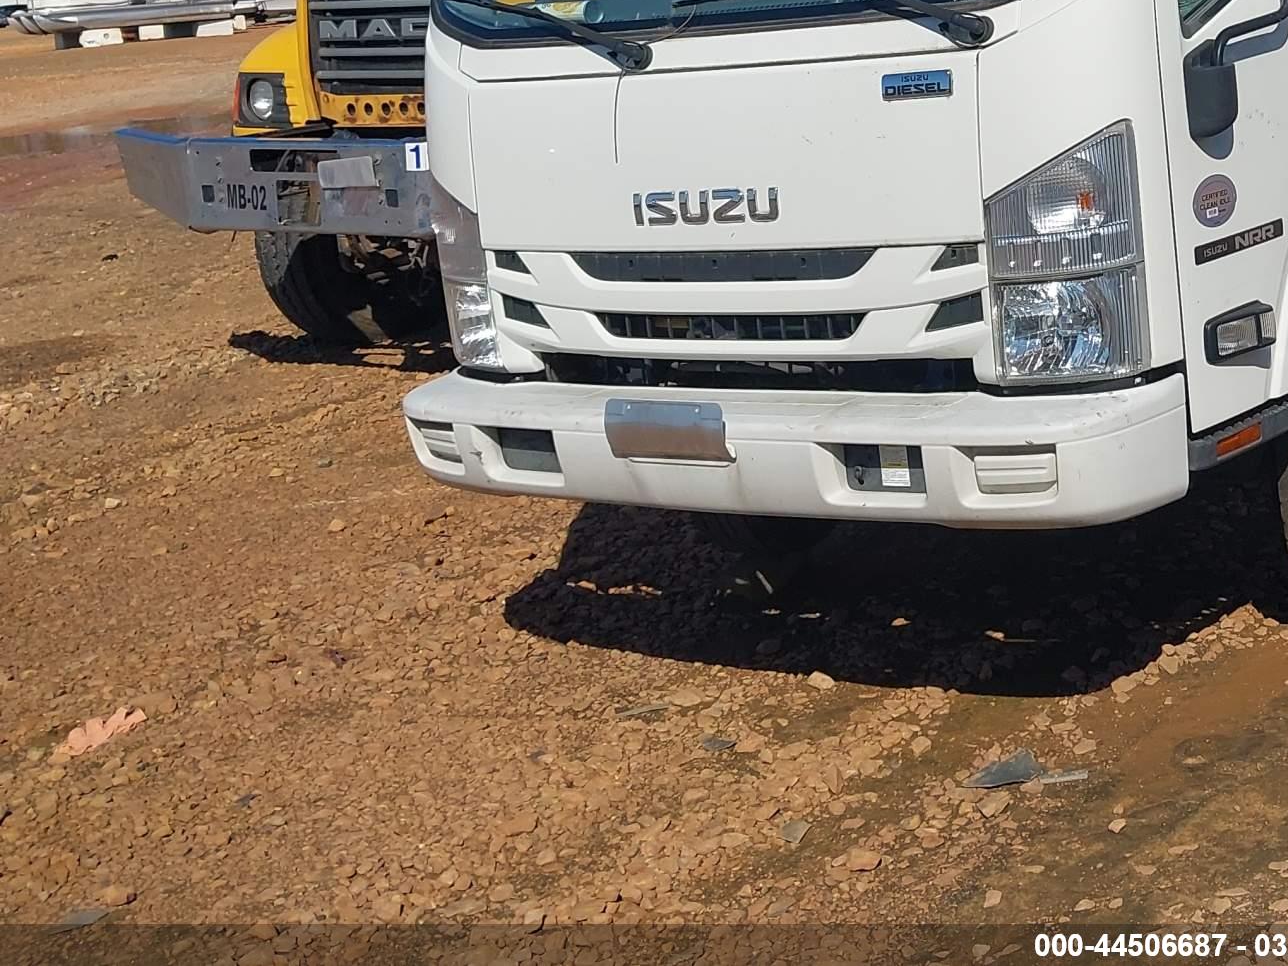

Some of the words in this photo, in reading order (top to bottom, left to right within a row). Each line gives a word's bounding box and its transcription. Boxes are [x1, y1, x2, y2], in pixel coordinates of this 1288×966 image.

[884, 82, 950, 97] DIESEL
[901, 74, 928, 83] ISUZU
[410, 144, 422, 169] 1
[226, 184, 267, 211] MB-02
[632, 186, 780, 227] ISUZU
[1199, 200, 1218, 211] CLEAN
[1203, 243, 1228, 258] ISUZU
[1234, 224, 1275, 250] NRR
